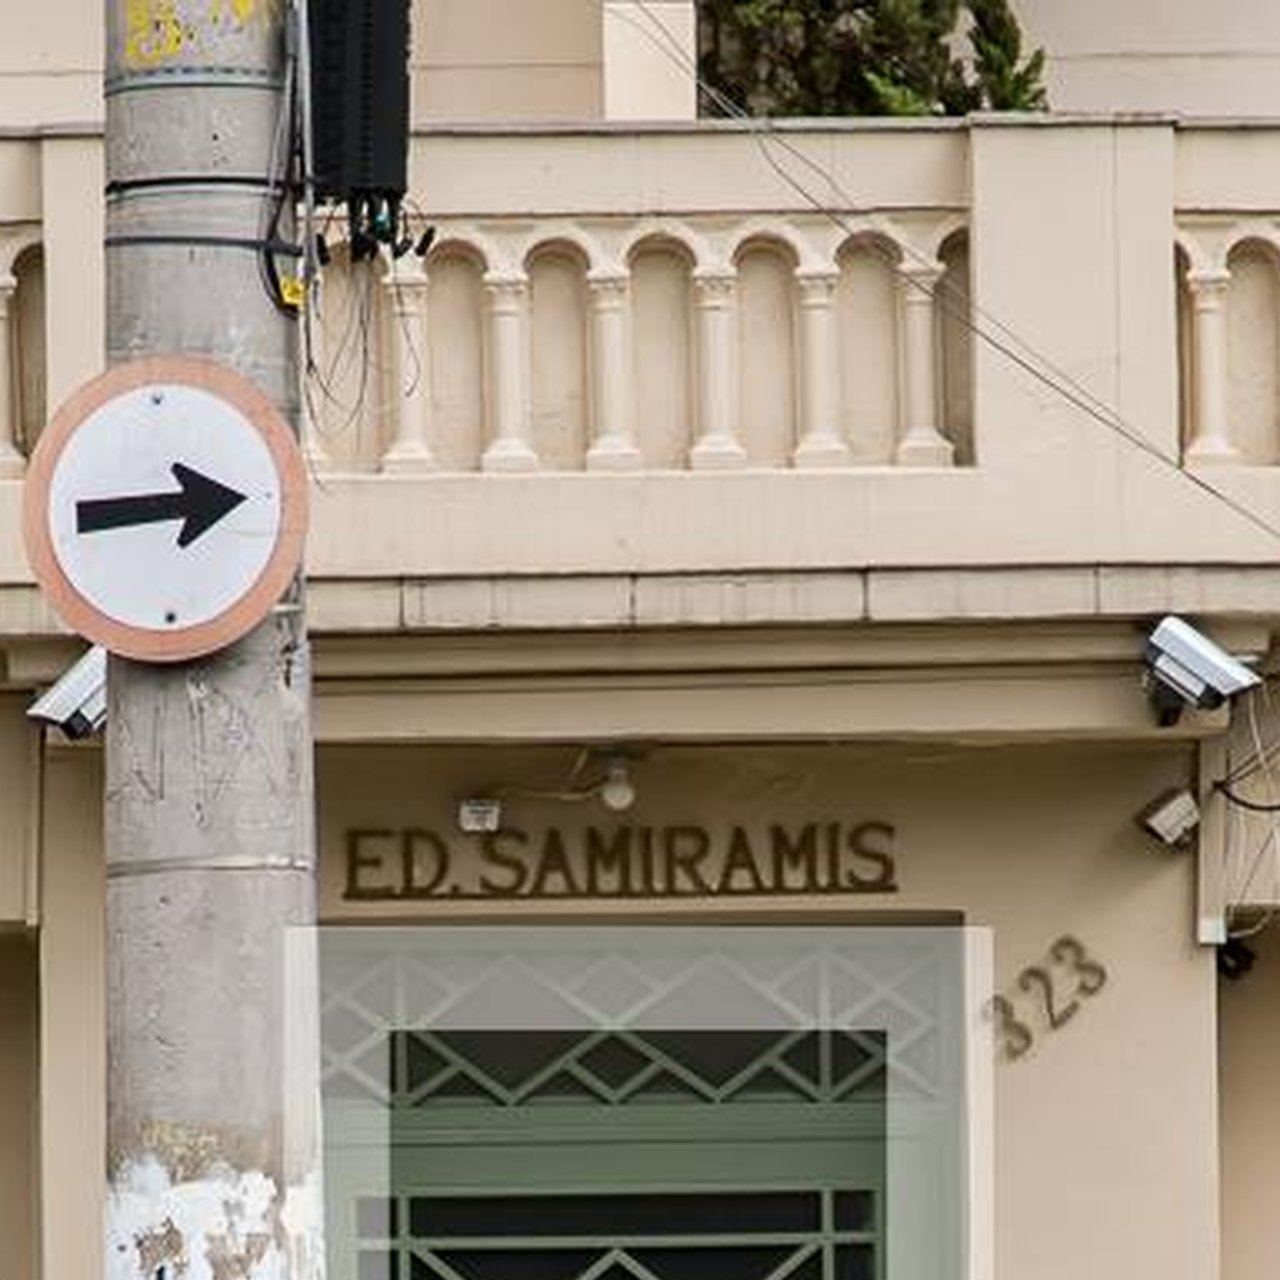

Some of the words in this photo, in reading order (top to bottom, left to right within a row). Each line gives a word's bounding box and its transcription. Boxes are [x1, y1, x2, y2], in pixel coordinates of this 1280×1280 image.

[342, 828, 460, 896] ED.
[479, 822, 898, 894] SAMIRAMIS
[983, 935, 1107, 1061] 323
